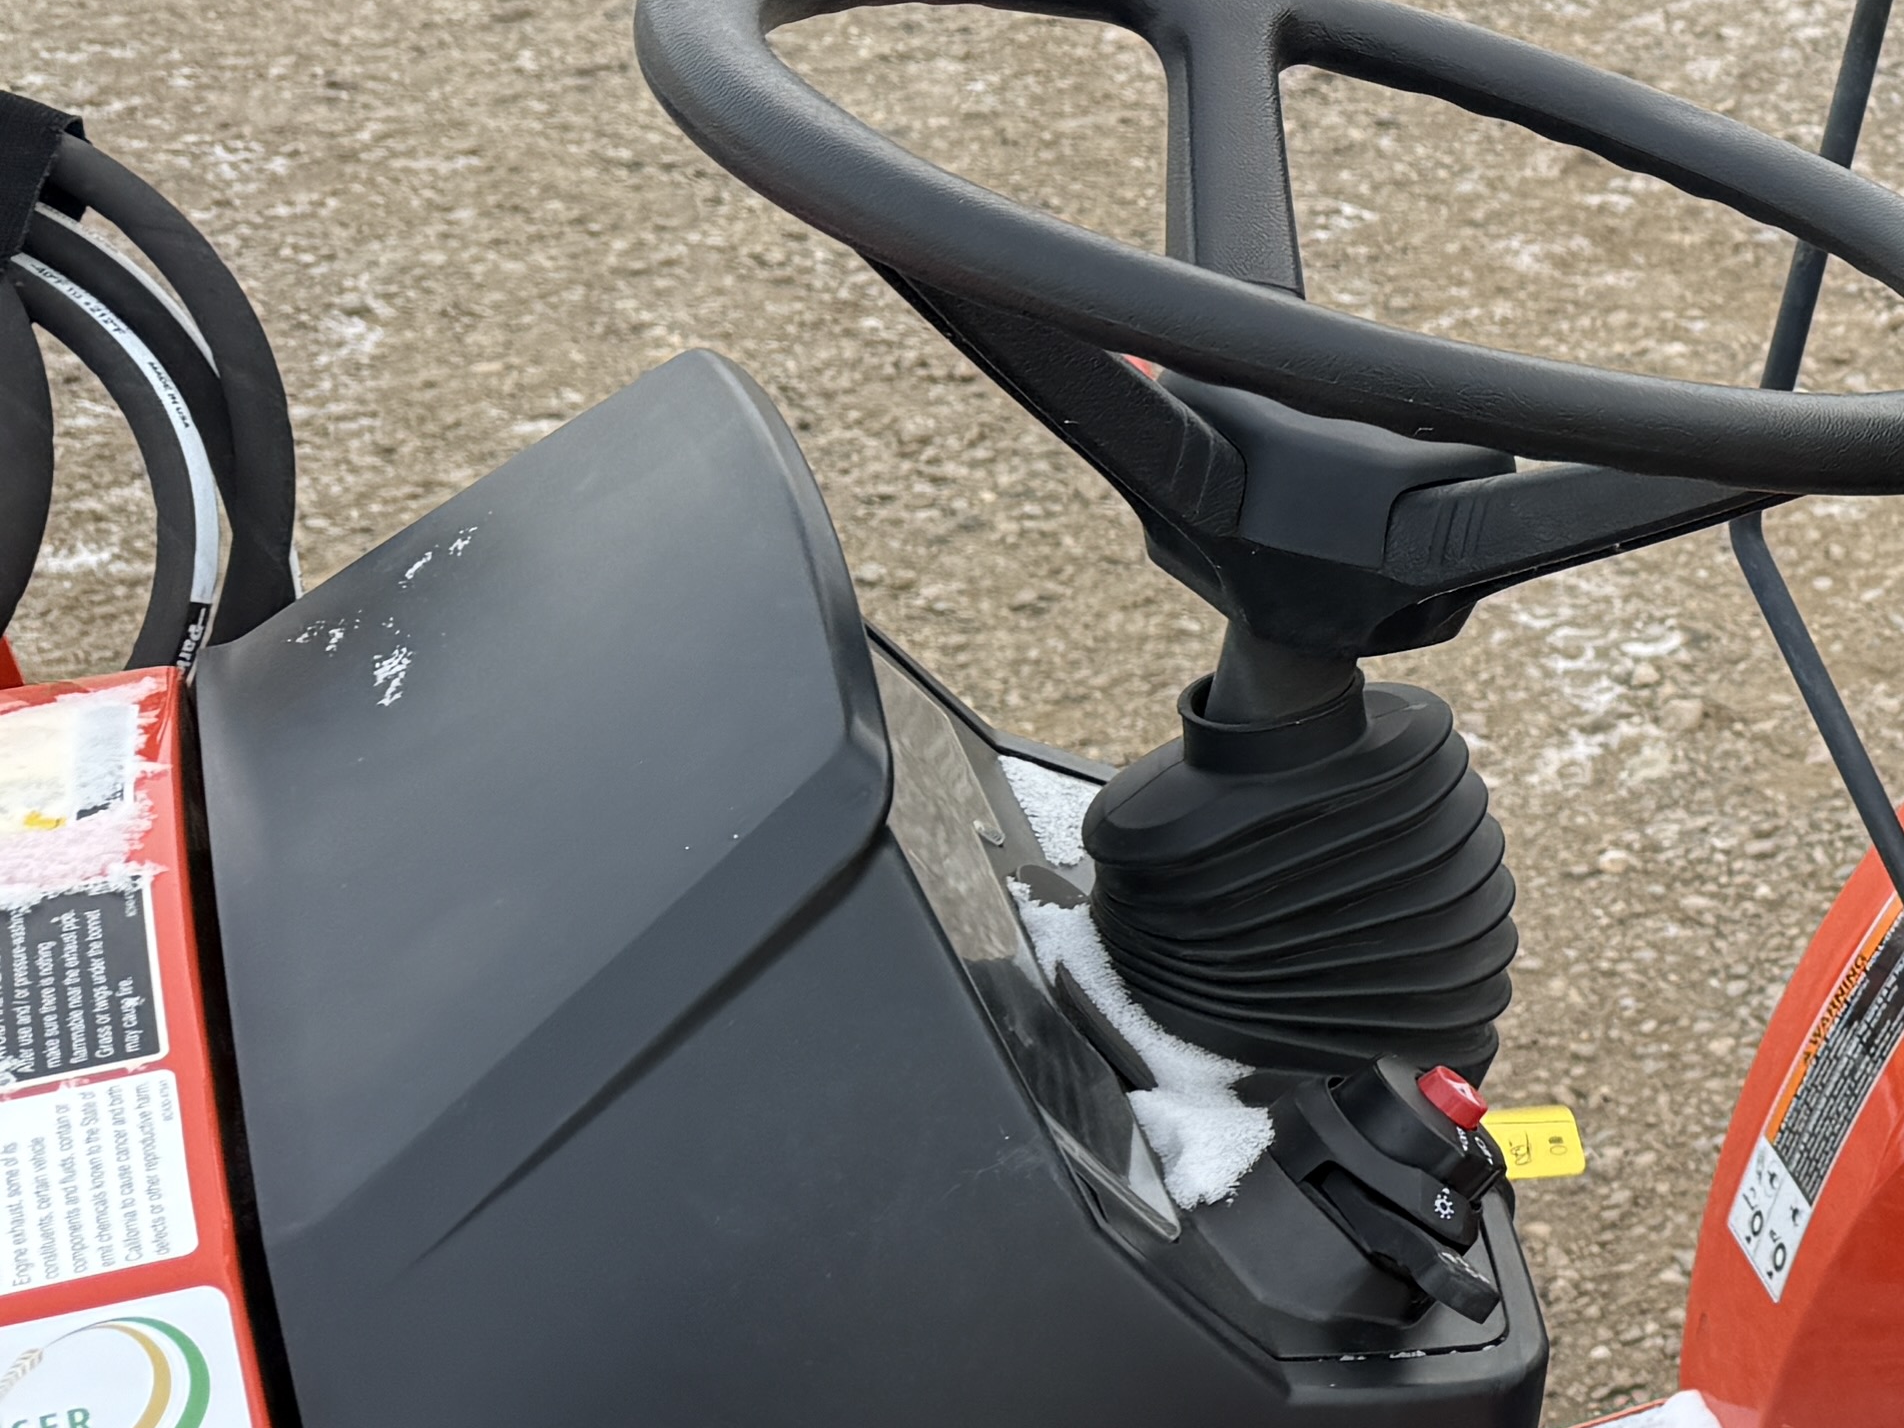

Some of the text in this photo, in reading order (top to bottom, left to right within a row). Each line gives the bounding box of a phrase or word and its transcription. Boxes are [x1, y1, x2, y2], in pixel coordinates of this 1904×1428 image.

[148, 361, 174, 392] MADE
[174, 406, 190, 428] USA
[13, 987, 30, 999] or
[34, 940, 62, 1069] make sure there is nothing
[59, 930, 88, 1064] flammable near the exhaust
[82, 908, 115, 1058] Grass or twigs under the bonnet
[114, 975, 134, 997] fire.
[1809, 954, 1868, 1046] WARNING
[11, 1004, 32, 1025] and
[16, 1025, 34, 1047] use
[123, 1028, 143, 1053] may
[136, 1109, 161, 1172] reproductive
[76, 1089, 116, 1268] emit chemicals known to the State of
[105, 1084, 143, 1262] California to cause cancer and birth
[144, 1173, 163, 1201] other
[148, 1202, 165, 1215] or
[149, 1215, 171, 1256] defects
